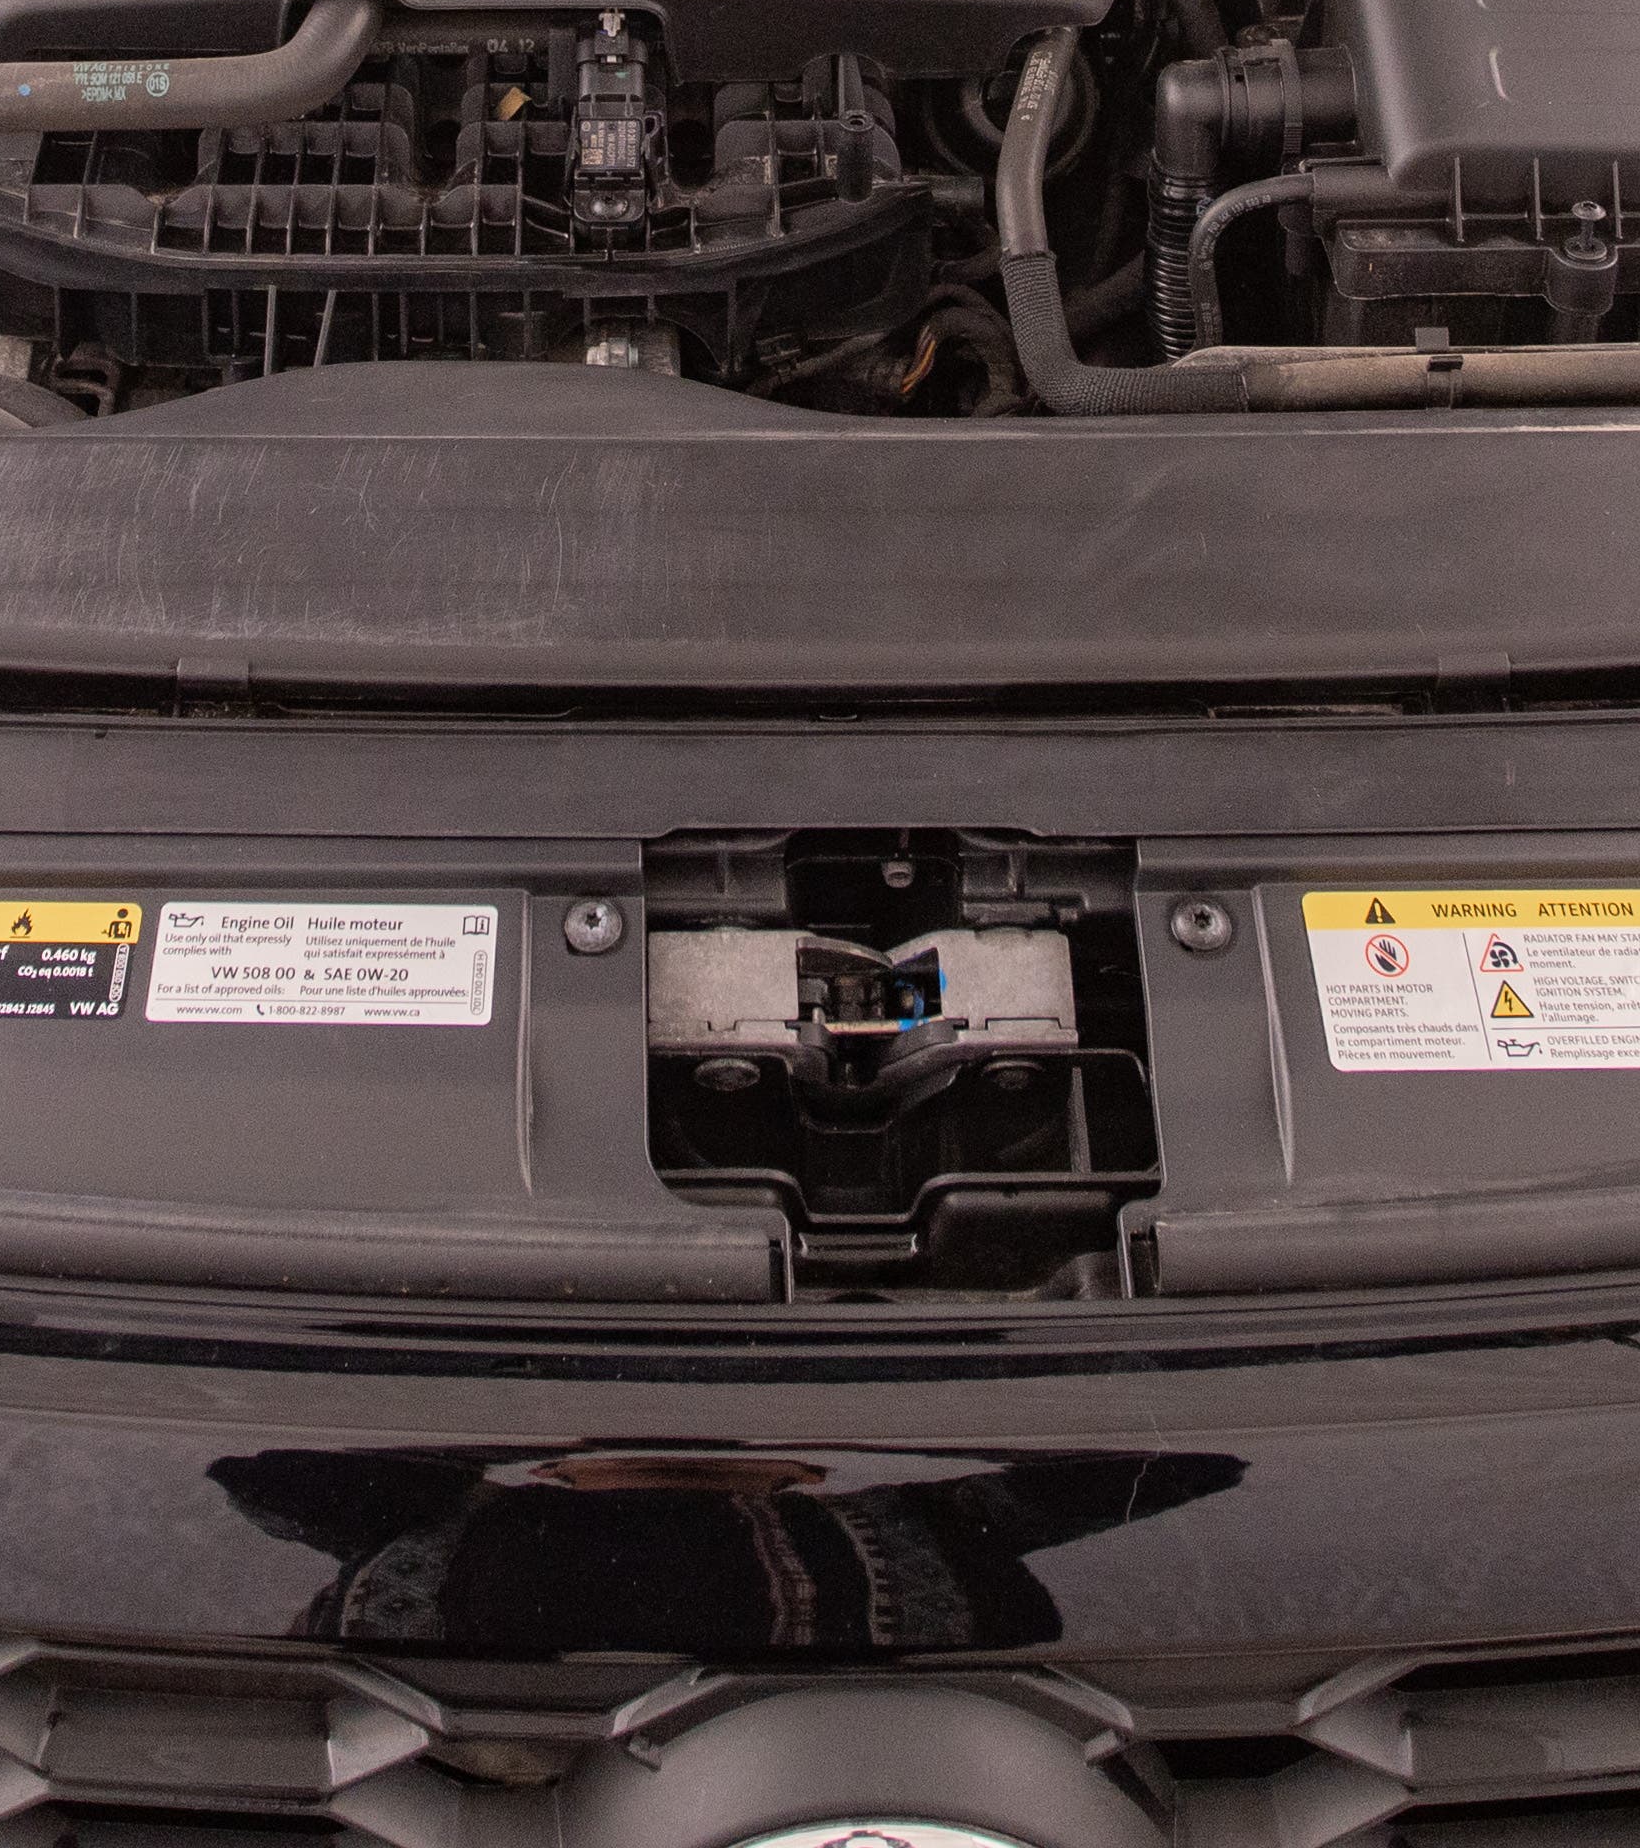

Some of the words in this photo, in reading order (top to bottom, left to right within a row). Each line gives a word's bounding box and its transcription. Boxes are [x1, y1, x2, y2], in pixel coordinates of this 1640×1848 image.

[1431, 903, 1517, 918] WARNING
[1538, 902, 1634, 917] ATTENTION
[221, 916, 270, 932] Engine
[273, 916, 295, 930] Oil
[308, 916, 346, 930] Huile
[349, 917, 403, 931] moteur
[165, 933, 184, 943] Use
[185, 933, 207, 945] only
[209, 933, 221, 943] oil
[223, 933, 244, 944] that
[245, 934, 292, 946] expressly
[305, 936, 343, 947] Utilisez
[345, 937, 408, 950] uniquement
[410, 937, 423, 948] de
[424, 937, 456, 948] l'huile
[1523, 934, 1573, 943] RADIATOR
[1575, 933, 1596, 943] FAN
[1597, 933, 1618, 943] MAY
[42, 949, 79, 962] 0.460
[80, 949, 97, 964] kg
[163, 945, 207, 958] complies
[209, 946, 232, 956] with
[303, 949, 321, 960] qui
[322, 948, 363, 959] satisfait
[365, 949, 437, 961] expressément
[438, 950, 446, 960] à
[1527, 947, 1539, 957] Le
[1541, 946, 1597, 957] ventilateur
[1599, 946, 1611, 957] de
[1529, 960, 1576, 969] moment.
[38, 967, 52, 978] eq
[87, 966, 94, 977] t
[211, 966, 239, 980] VW
[242, 966, 270, 980] 508
[275, 967, 296, 981] 00
[304, 969, 315, 981] &
[324, 967, 353, 981] SAE
[357, 968, 409, 982] 0W-20
[1533, 976, 1559, 986] HIGH
[157, 983, 173, 994] For
[175, 986, 182, 994] a
[183, 983, 199, 994] list
[201, 983, 213, 994] of
[214, 984, 261, 997] approved
[264, 985, 286, 995] oils:
[300, 985, 323, 996] Pour
[325, 987, 344, 996] une
[346, 985, 367, 997] liste
[368, 986, 406, 998] d'huiles
[473, 982, 482, 997] 010
[1326, 984, 1347, 994] HOT
[1349, 984, 1381, 994] PARTS
[1383, 984, 1394, 993] IN
[1396, 984, 1434, 993] MOTOR
[1536, 988, 1582, 997] IGNITION
[1328, 996, 1409, 1006] COMPARTMENT.
[1539, 1001, 1570, 1011] Haute
[1573, 1001, 1614, 1012] tension,
[69, 1002, 94, 1015] VW
[96, 1002, 119, 1015] AG
[176, 1005, 243, 1015] www.vw.com
[268, 1005, 346, 1017] 1-800-822-8987
[364, 1007, 421, 1017] www.vw.ca
[1330, 1008, 1372, 1018] MOVING
[1375, 1008, 1410, 1018] PARTS.
[1333, 1024, 1395, 1035] Composants
[1396, 1023, 1416, 1033] très
[1418, 1023, 1454, 1033] chauds
[1455, 1023, 1479, 1033] dans
[1336, 1037, 1345, 1047] le
[1347, 1037, 1422, 1048] compartiment
[1424, 1037, 1465, 1047] moteur.
[1547, 1035, 1609, 1045] OVERFILLED
[1338, 1050, 1371, 1060] Pièces
[1373, 1051, 1387, 1059] en
[1389, 1049, 1455, 1059] mouvement.
[1550, 1048, 1613, 1060] Remplissage
